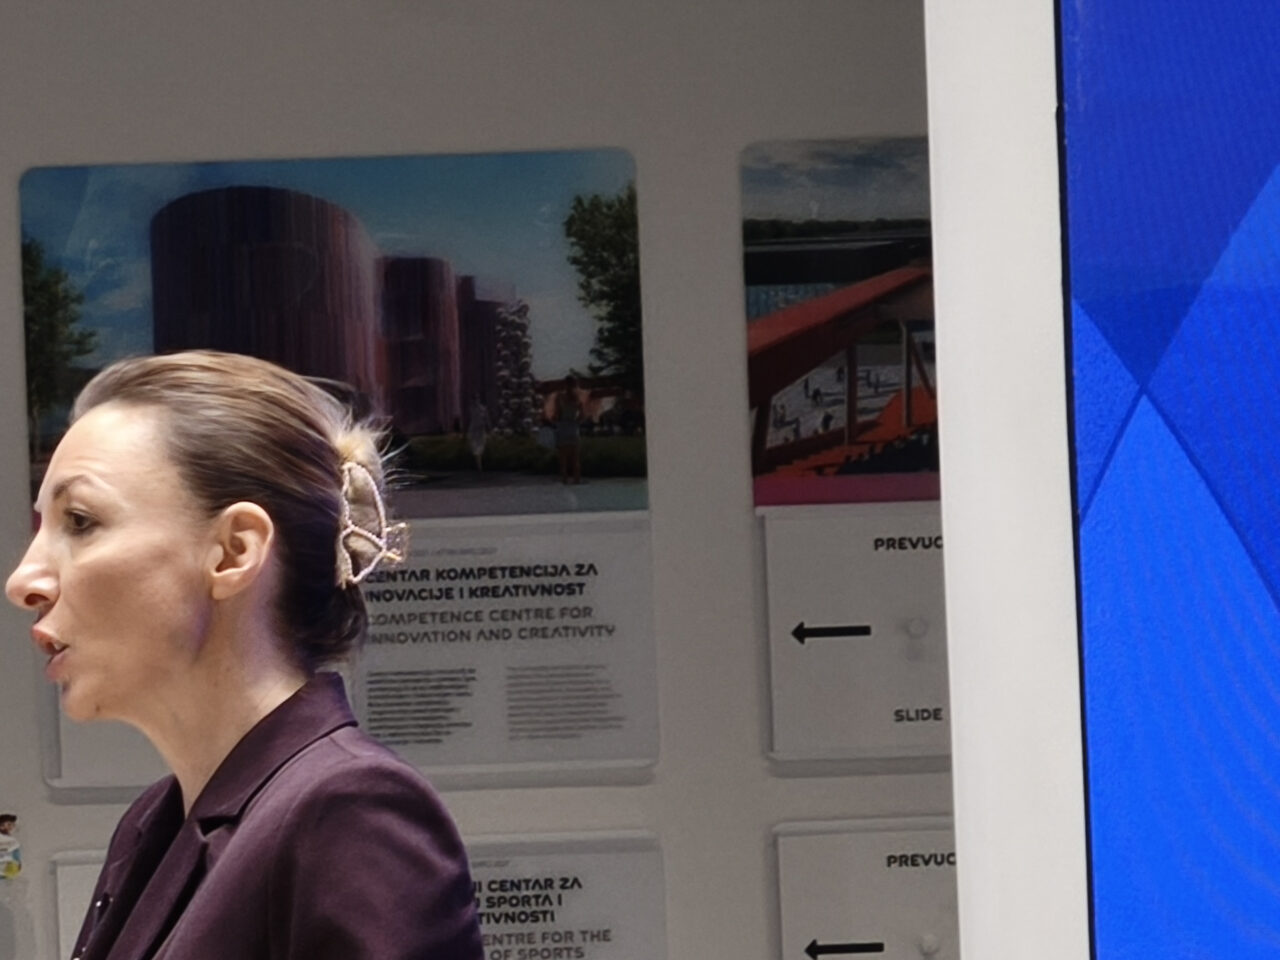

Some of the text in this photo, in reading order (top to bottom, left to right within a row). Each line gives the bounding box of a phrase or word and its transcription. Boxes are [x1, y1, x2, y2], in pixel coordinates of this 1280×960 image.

[435, 565, 570, 582] KOMPETENCIJA
[574, 563, 598, 577] ZA
[460, 586, 464, 600] I
[468, 582, 586, 600] KREATIVNOST
[488, 608, 555, 623] CENTRE
[559, 606, 594, 620] FOR
[476, 627, 512, 642] AND
[517, 624, 616, 640] CREATIVITY
[893, 708, 943, 723] SLIDE
[487, 878, 554, 893] CENTAR
[559, 876, 582, 890] ZA
[486, 893, 553, 909] SPORTA
[541, 930, 574, 944] FOR
[579, 928, 612, 943] THE
[517, 946, 585, 960] SPORTS
